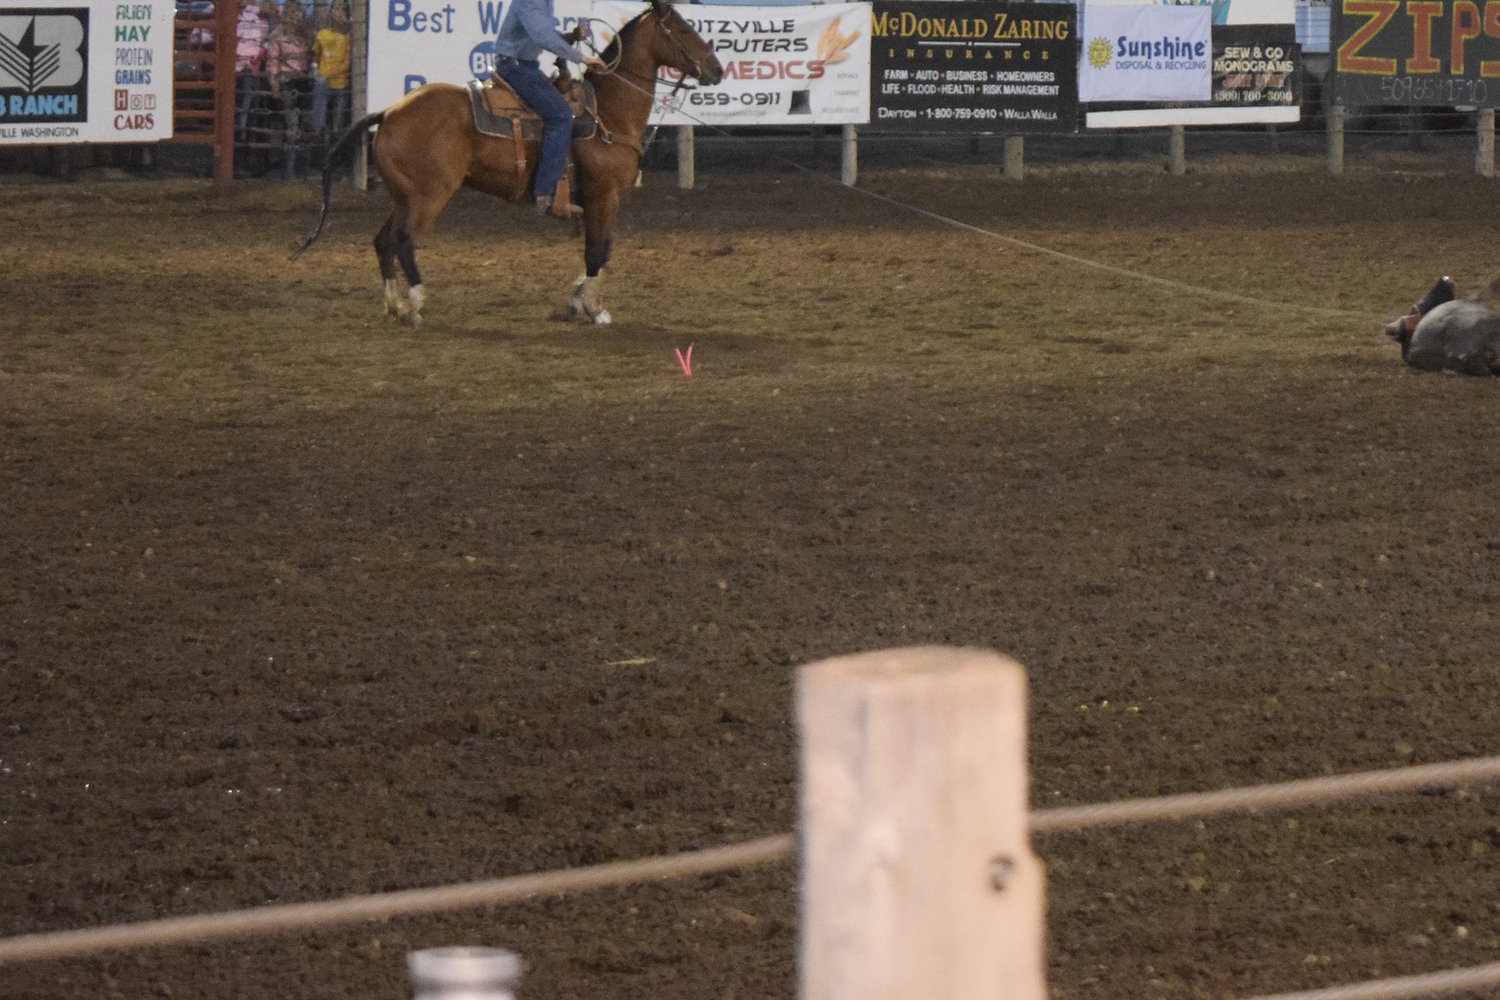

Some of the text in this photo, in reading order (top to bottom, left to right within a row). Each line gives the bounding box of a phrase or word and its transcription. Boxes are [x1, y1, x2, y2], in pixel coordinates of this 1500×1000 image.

[115, 25, 150, 42] HAY
[994, 13, 1069, 40] ZARING
[889, 49, 1049, 60] INSURANCE
[1117, 35, 1206, 60] Sunshine
[1224, 47, 1283, 59] SEW & GO
[116, 48, 153, 65] PROTEIN
[1115, 60, 1207, 70] DISPOSAL & RECYCLING
[1213, 60, 1294, 72] MONOGRAMS
[115, 69, 152, 85] GRAINS
[884, 69, 1055, 82] FARM AUTO BUSINESS HOMEOWNERS
[881, 84, 1060, 96] LIFE FLOOD HEALTH RISK MANAGEMENT
[10, 94, 78, 116] RANCH
[114, 89, 156, 111] HOT
[690, 91, 781, 106] 659-0911
[878, 107, 917, 119] DAYTON
[1004, 109, 1030, 120] WALLA
[1031, 109, 1058, 120] WALLA
[114, 113, 155, 131] CARS
[0, 126, 79, 138] ILLE WASHINGTON
